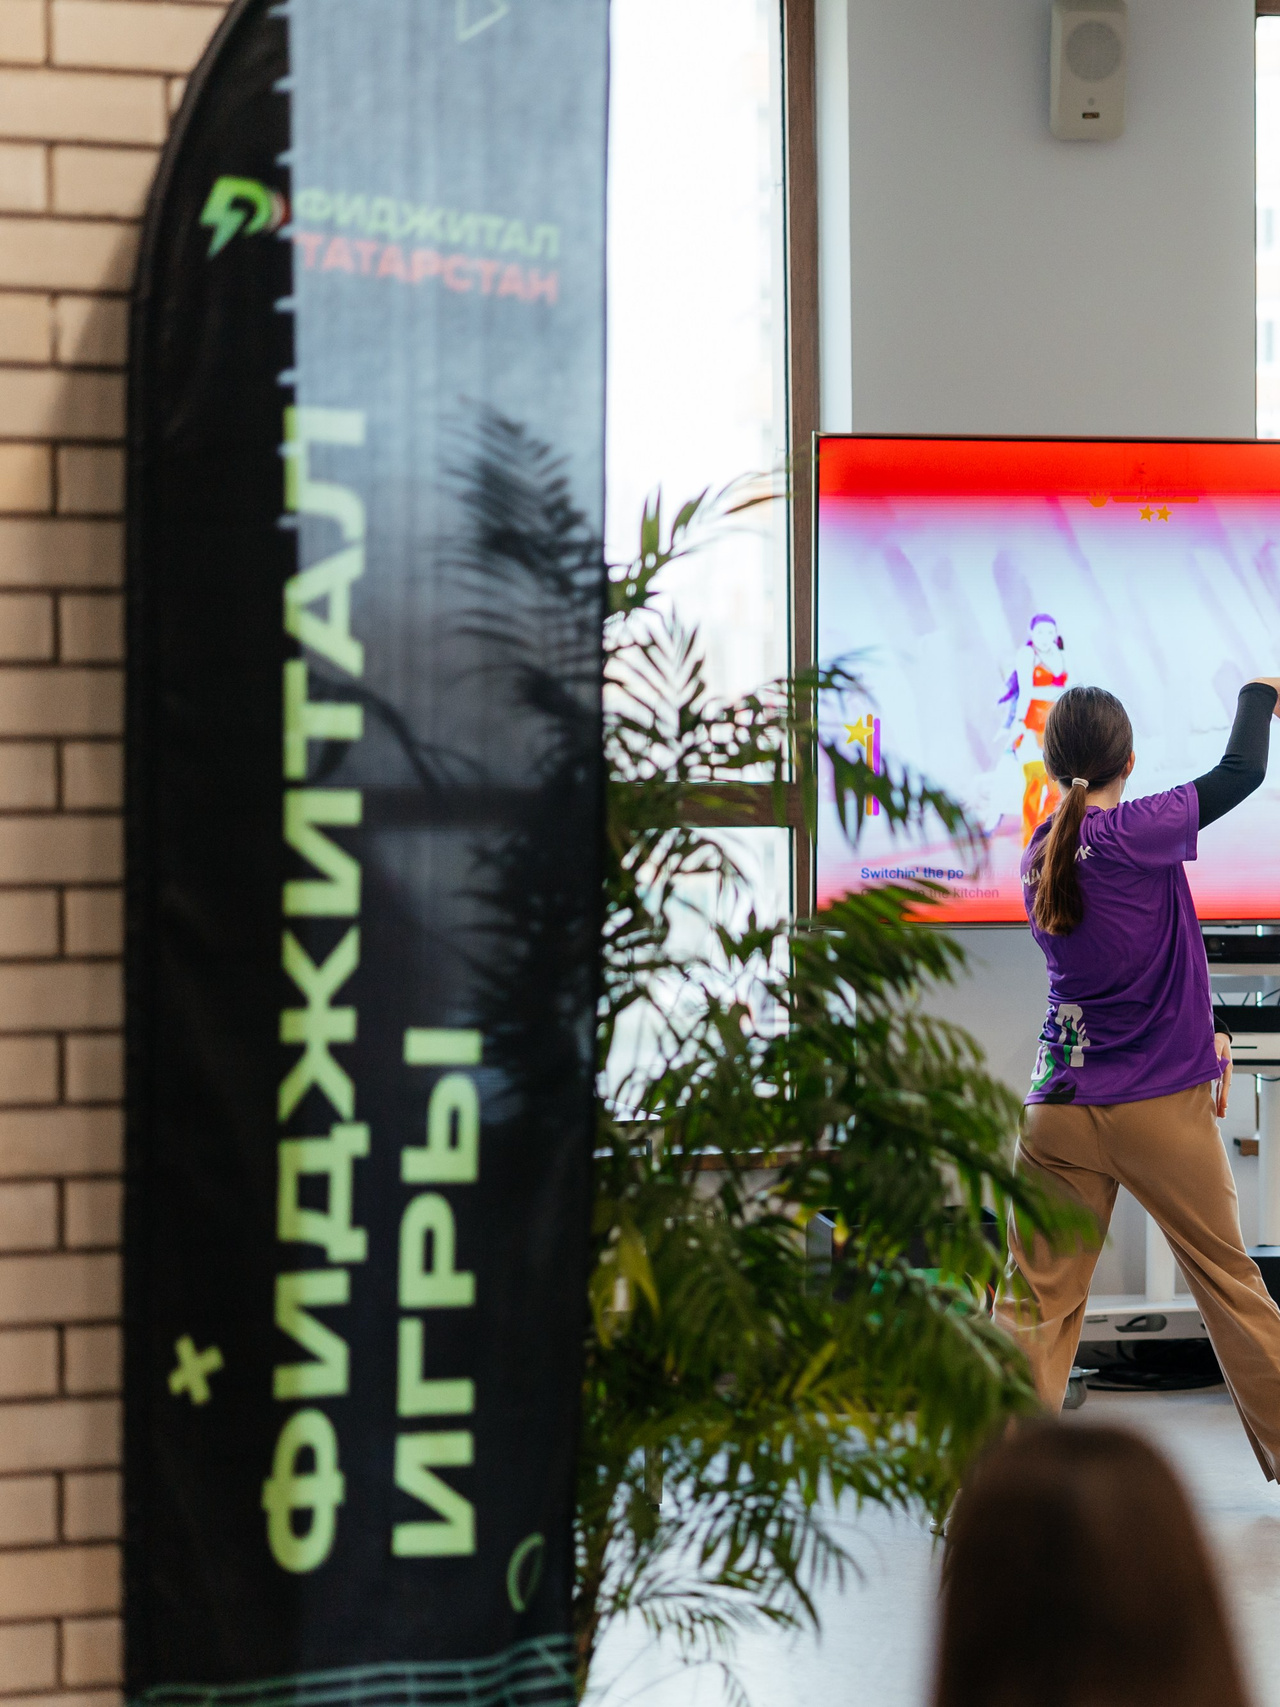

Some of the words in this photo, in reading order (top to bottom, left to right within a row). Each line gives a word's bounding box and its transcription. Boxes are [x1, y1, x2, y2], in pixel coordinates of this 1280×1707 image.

[298, 187, 562, 261] ФИДЖИТАЛ
[296, 231, 559, 304] ТАТАРСТАН
[861, 867, 919, 879] Switchin'
[923, 867, 944, 879] the
[953, 887, 999, 899] kitchen
[261, 405, 370, 1574] ФИДЖИТАЛ
[392, 1026, 483, 1558] ИГРЫ
